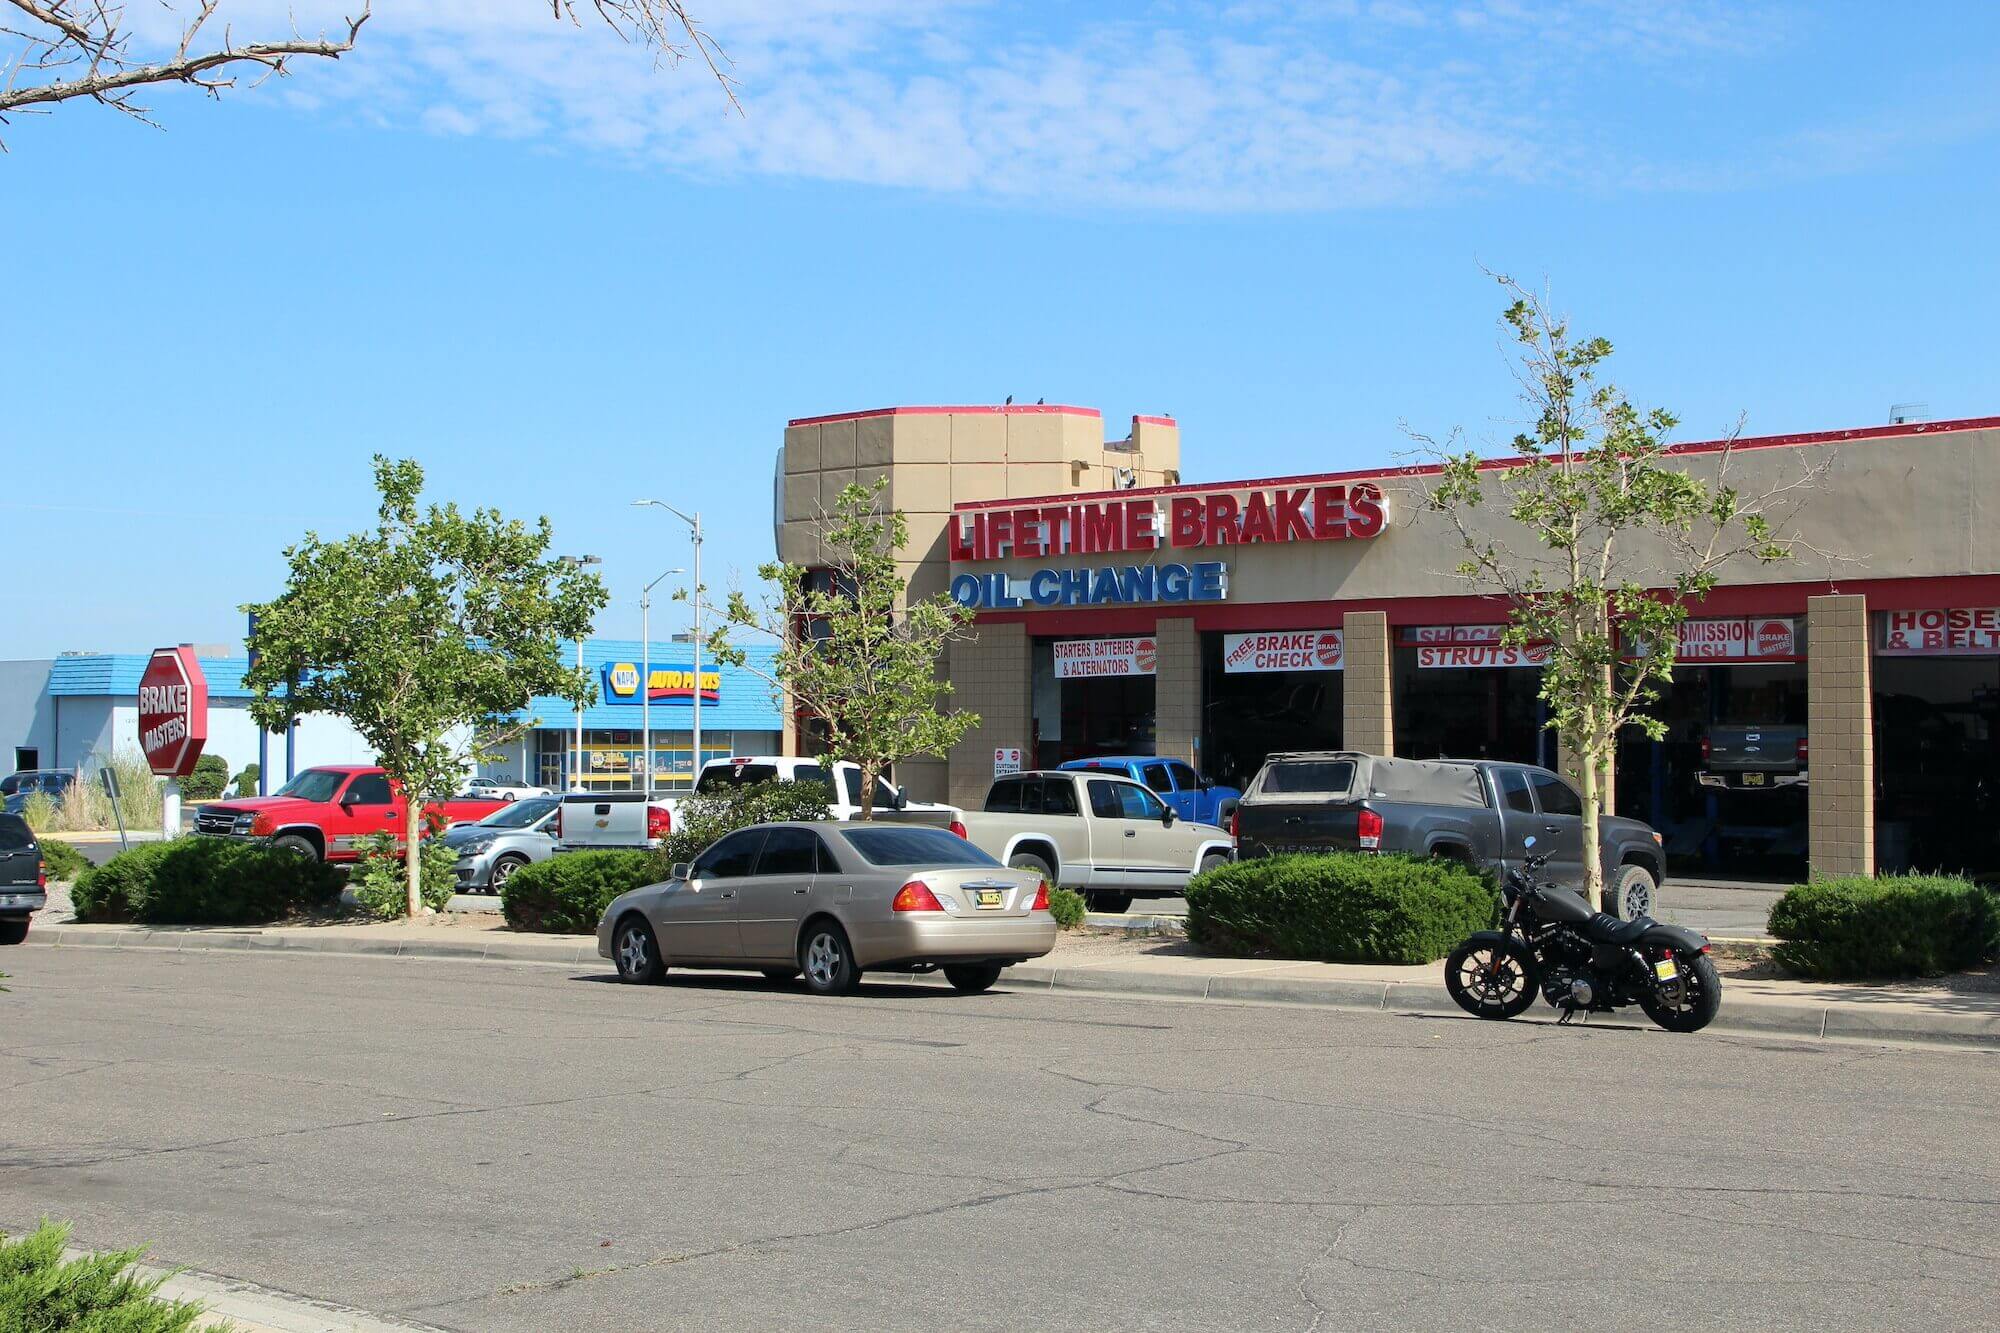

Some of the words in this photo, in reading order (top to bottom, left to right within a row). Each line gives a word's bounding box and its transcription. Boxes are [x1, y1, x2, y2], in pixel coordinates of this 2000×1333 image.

[950, 500, 1160, 561] LIFETIME
[1171, 482, 1390, 548] BRAKES
[951, 572, 1023, 609] OIL
[1030, 561, 1229, 605] CHANGE
[1892, 610, 2000, 630] HOSE
[1641, 622, 1755, 641] SMISSION
[1759, 633, 1790, 641] BRAKE
[1888, 631, 1910, 649] &
[1055, 643, 1093, 659] STARTERS,
[1095, 640, 1134, 656] BATTERIES
[1226, 637, 1255, 667] FREE
[1256, 635, 1314, 651] BRAKE
[1762, 641, 1791, 653] MASTERS
[1255, 652, 1313, 668] CHECK
[1420, 647, 1518, 666] STRUTS
[1063, 662, 1069, 676] &
[1071, 658, 1129, 676] ALTERNATORS
[616, 671, 635, 685] NAPA
[648, 671, 683, 689] AUTO
[140, 684, 186, 714] BRAKE
[145, 715, 185, 753] MASTERS
